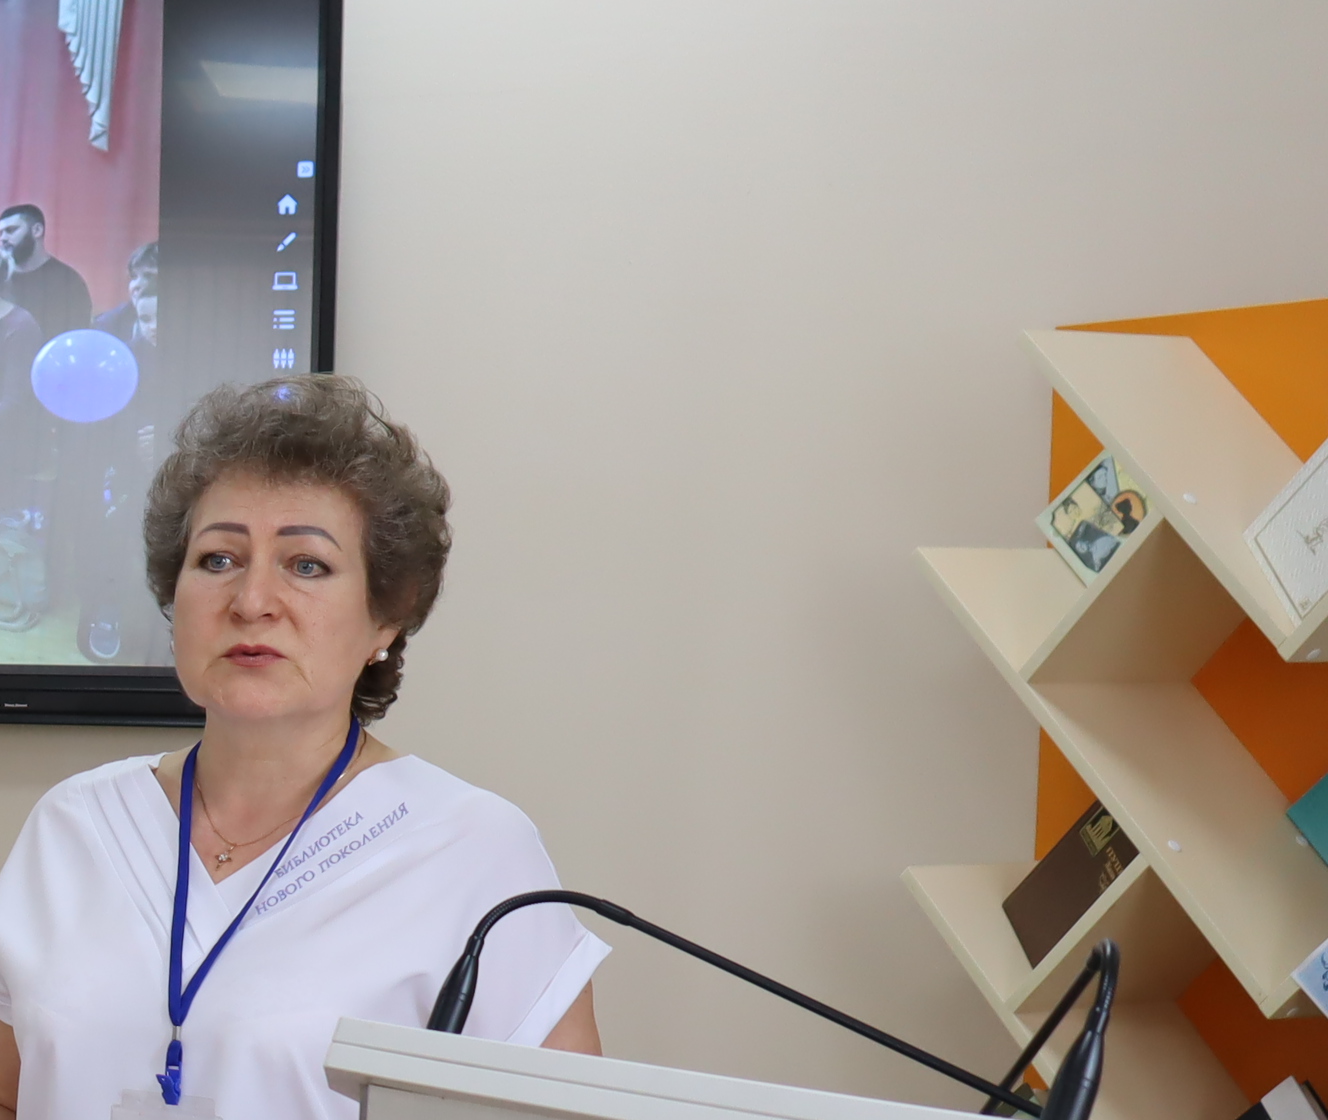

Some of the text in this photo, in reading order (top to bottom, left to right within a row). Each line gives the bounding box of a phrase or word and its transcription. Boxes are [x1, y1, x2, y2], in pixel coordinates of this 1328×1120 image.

[255, 802, 409, 915] НОВОГО ПОКОЛЕНИЯ
[274, 811, 364, 879] БИБЛИОТЕКА
